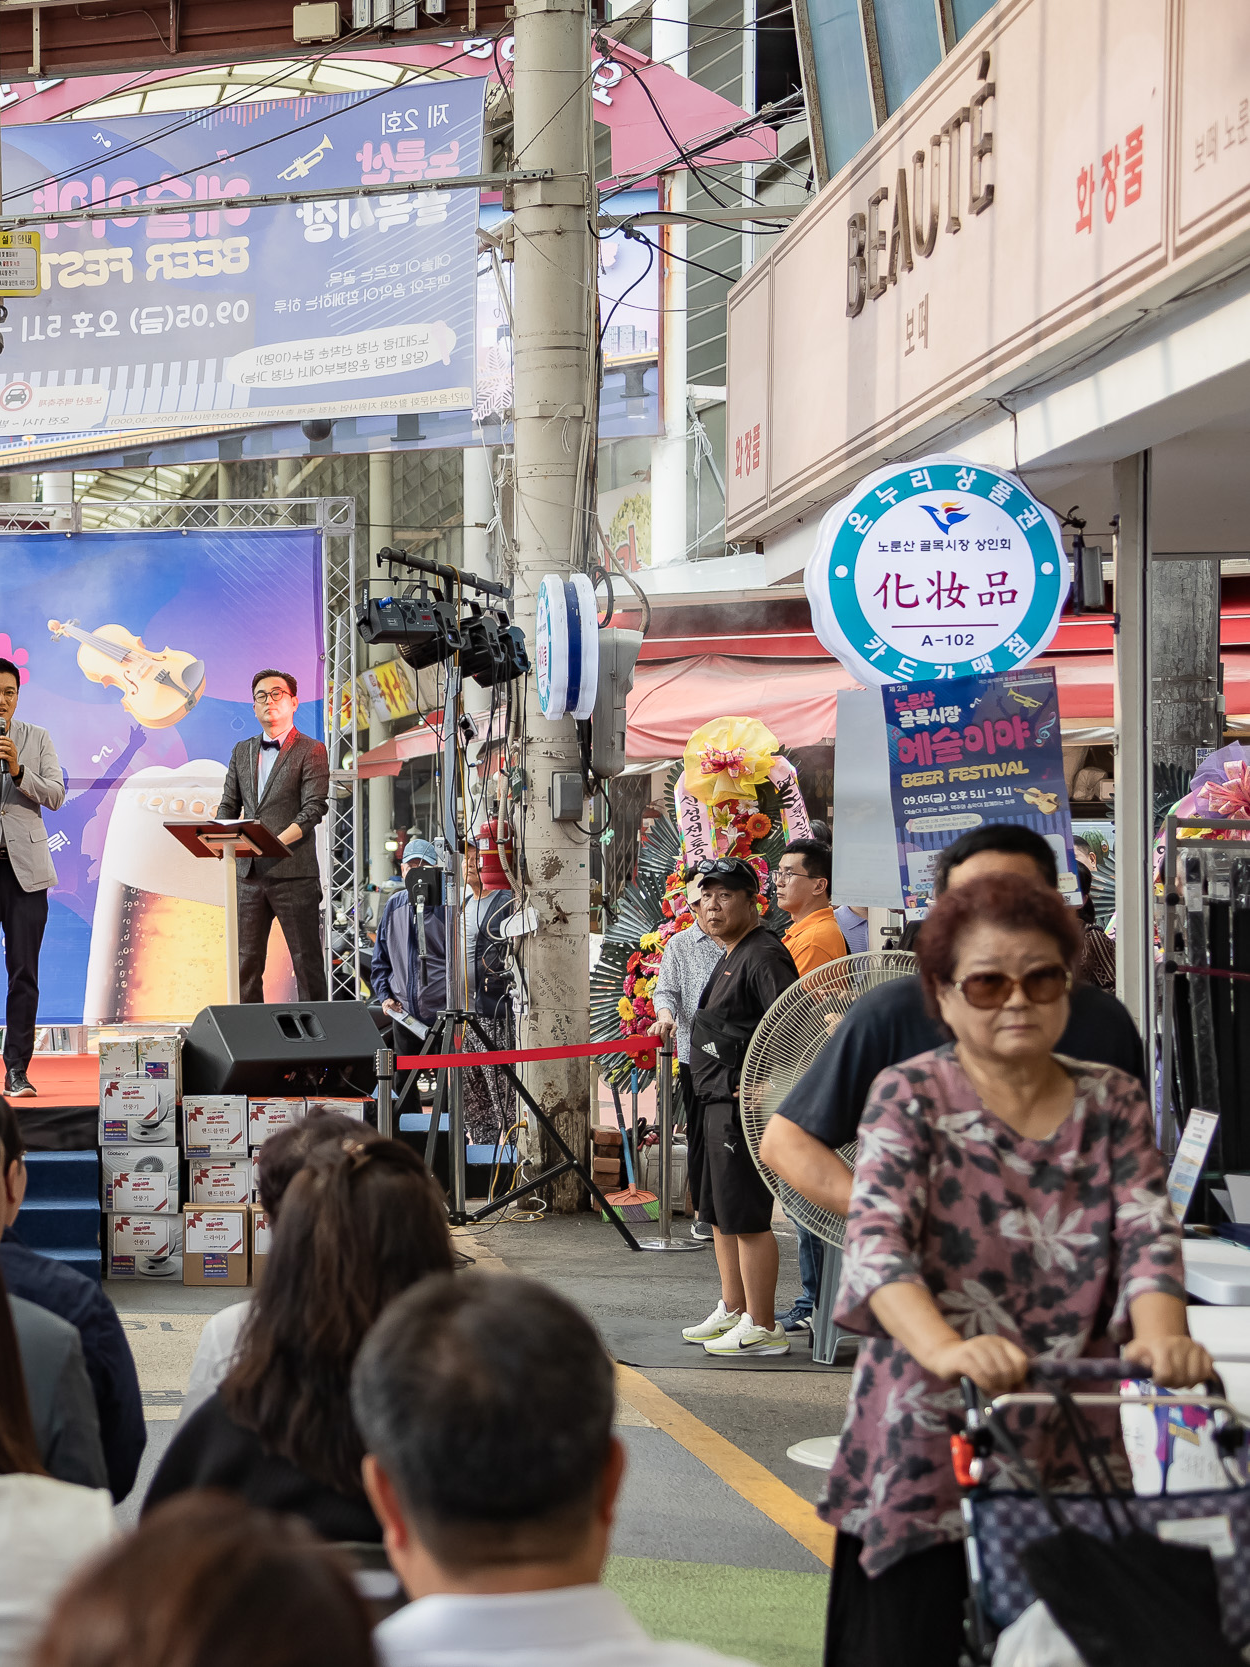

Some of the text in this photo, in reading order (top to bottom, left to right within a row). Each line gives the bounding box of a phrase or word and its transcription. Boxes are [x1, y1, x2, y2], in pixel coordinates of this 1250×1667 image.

[846, 51, 996, 318] BEAUTÉ
[1075, 124, 1144, 236] 화장품
[904, 292, 930, 357] 보떼
[735, 422, 760, 479] 화장품
[878, 538, 1011, 552] 노룬산 골목시장 상인회
[872, 570, 1019, 611] 化妆品
[921, 633, 975, 647] A-102
[894, 690, 936, 712] 노룬산
[899, 705, 962, 728] 골목시장
[897, 715, 1031, 766] 예술이야
[901, 760, 1030, 789] BEER FESTIVAL
[902, 793, 947, 806] 09.05(금)
[948, 790, 968, 801] 오후
